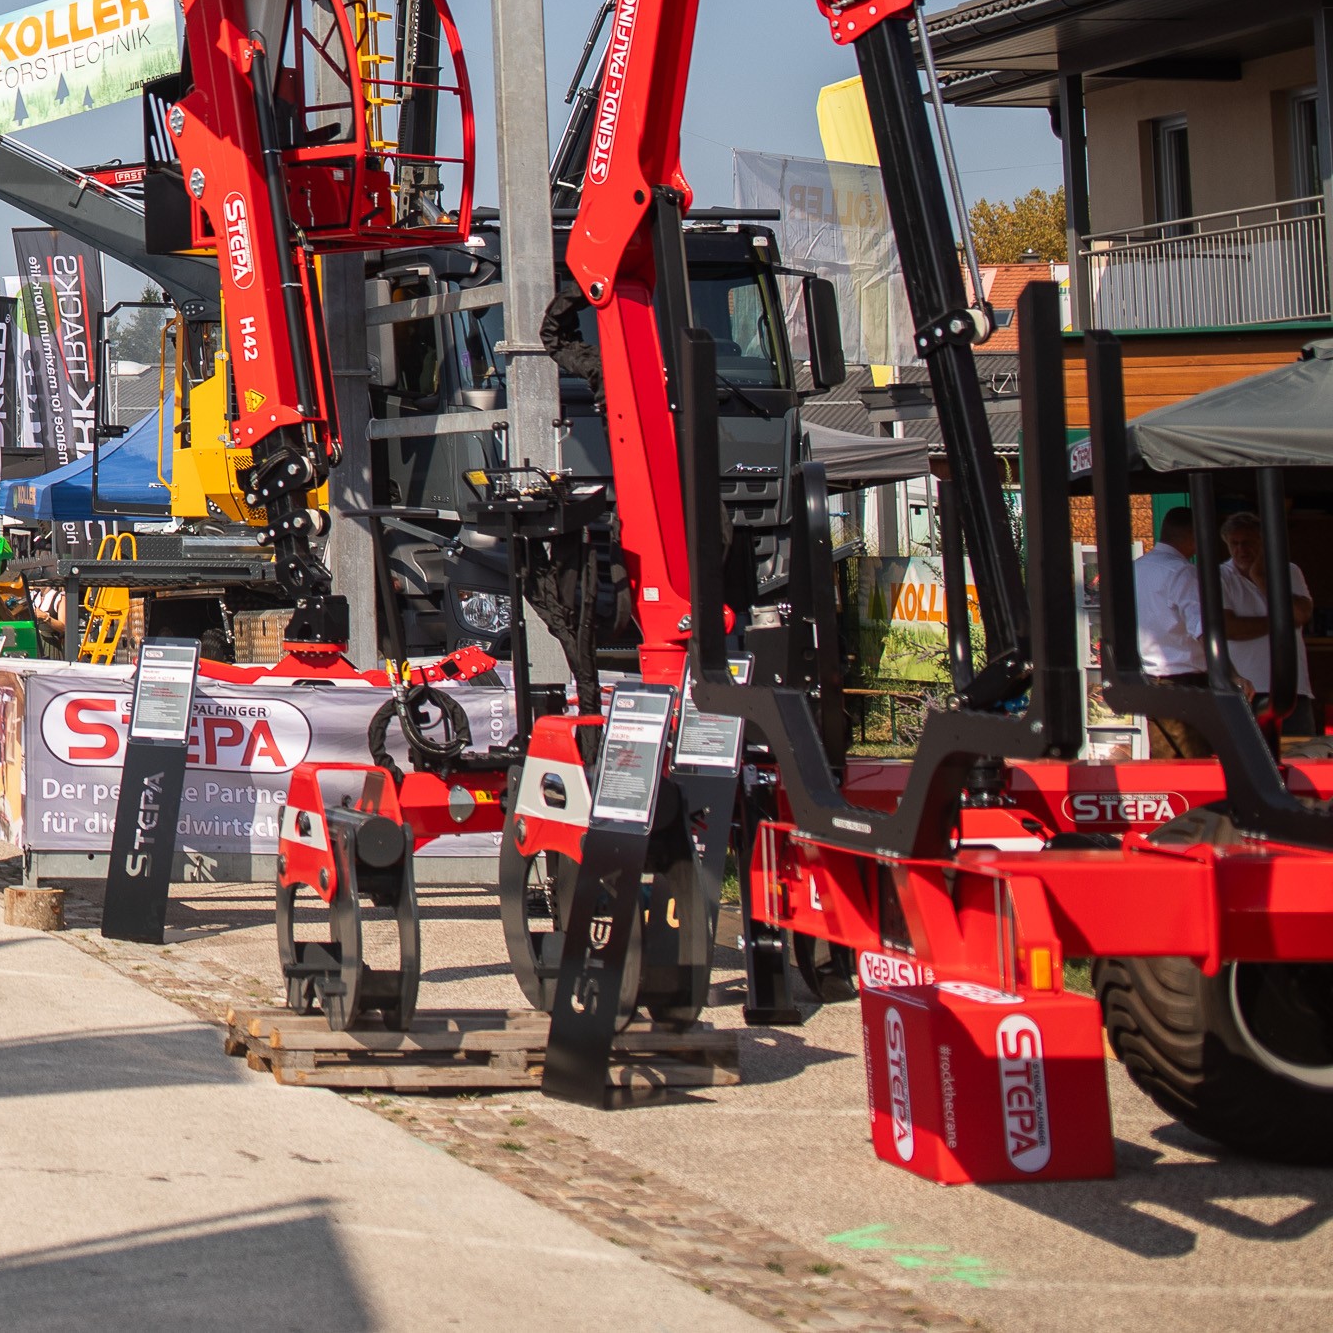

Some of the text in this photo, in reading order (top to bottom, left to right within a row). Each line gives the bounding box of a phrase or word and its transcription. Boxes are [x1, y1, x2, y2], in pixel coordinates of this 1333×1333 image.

[226, 199, 252, 282] STEPA
[240, 317, 258, 361] H42
[890, 581, 981, 623] KOLLR
[64, 698, 287, 767] SEPA
[41, 815, 79, 835] für
[42, 778, 87, 800] Der
[204, 778, 288, 804] Partne
[125, 771, 165, 878] STEPA
[1073, 795, 1177, 821] STEPA
[887, 1020, 909, 1142] STEPA
[938, 1044, 957, 1149] #rockthecrane
[1001, 1028, 1039, 1158] STEPA
